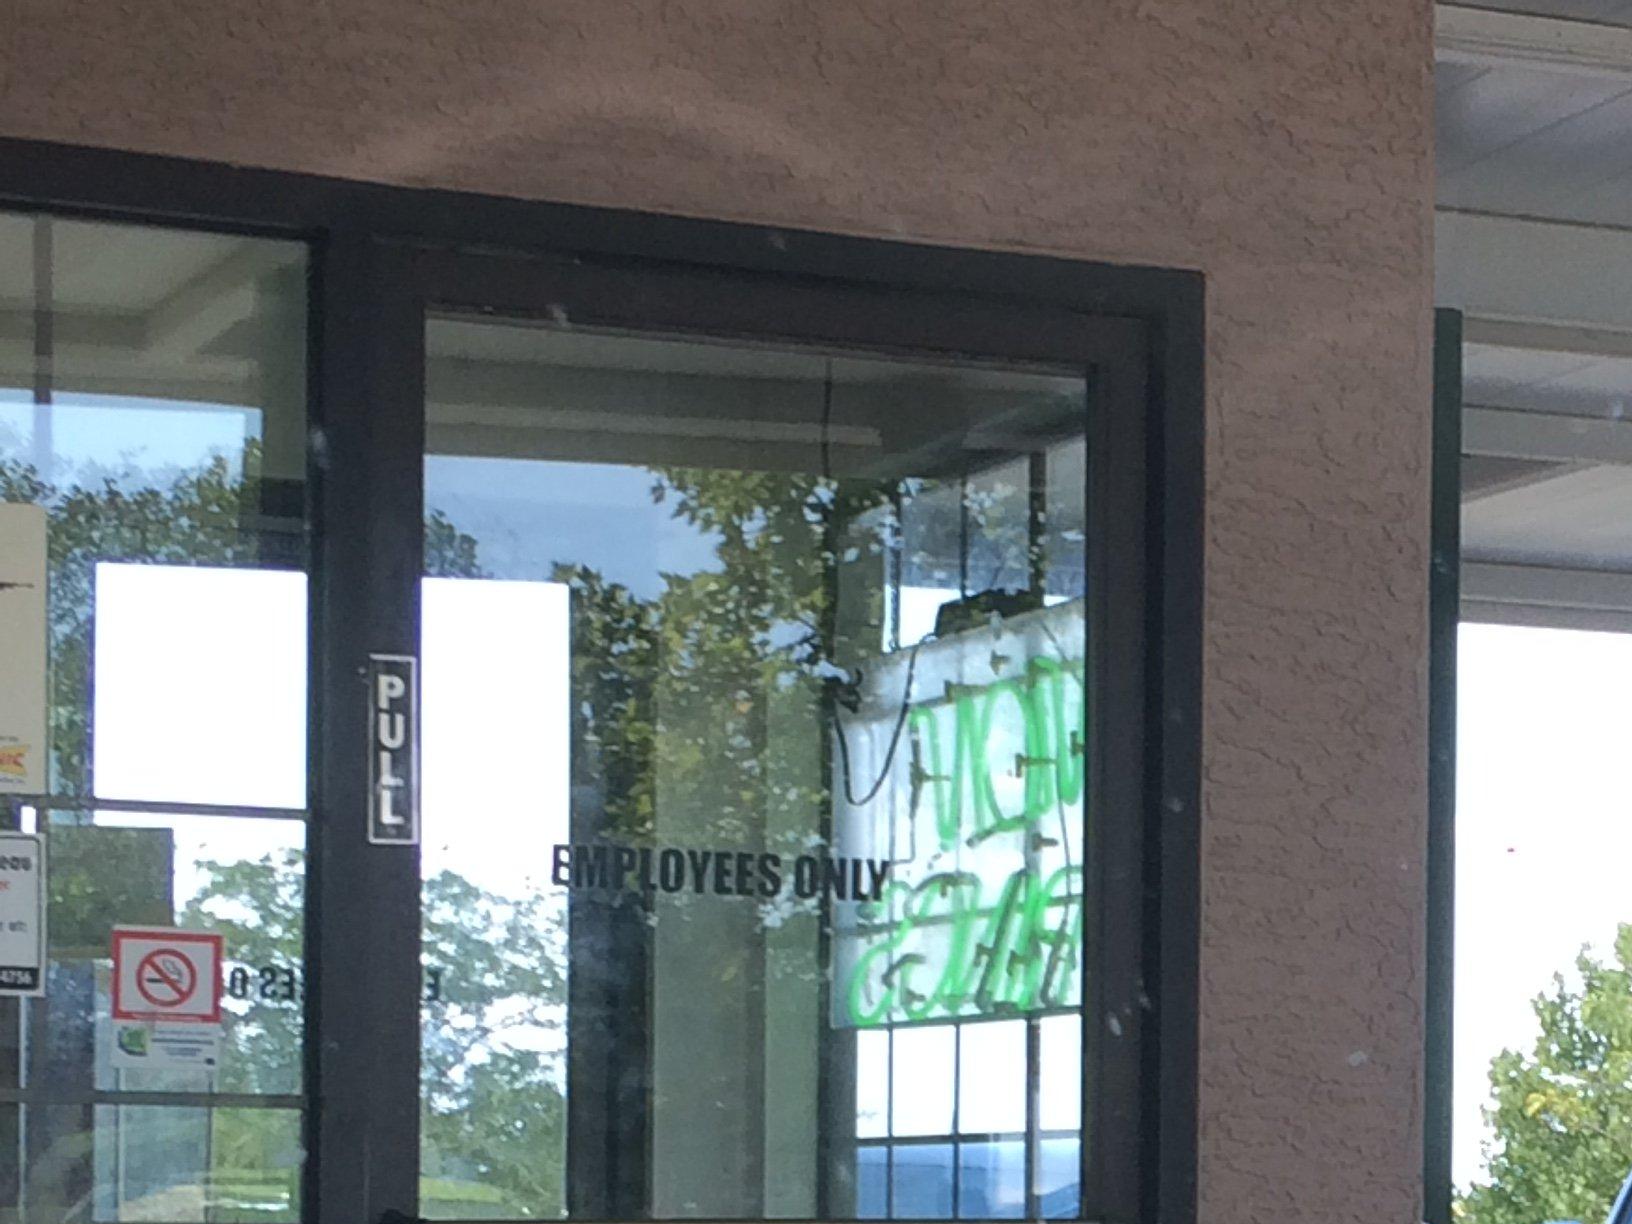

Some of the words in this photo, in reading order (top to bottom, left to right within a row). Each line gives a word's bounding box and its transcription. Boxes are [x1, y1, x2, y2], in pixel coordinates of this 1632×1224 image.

[378, 674, 405, 825] PULL
[551, 844, 781, 896] EMPLOYEES
[794, 855, 890, 901] ONLY
